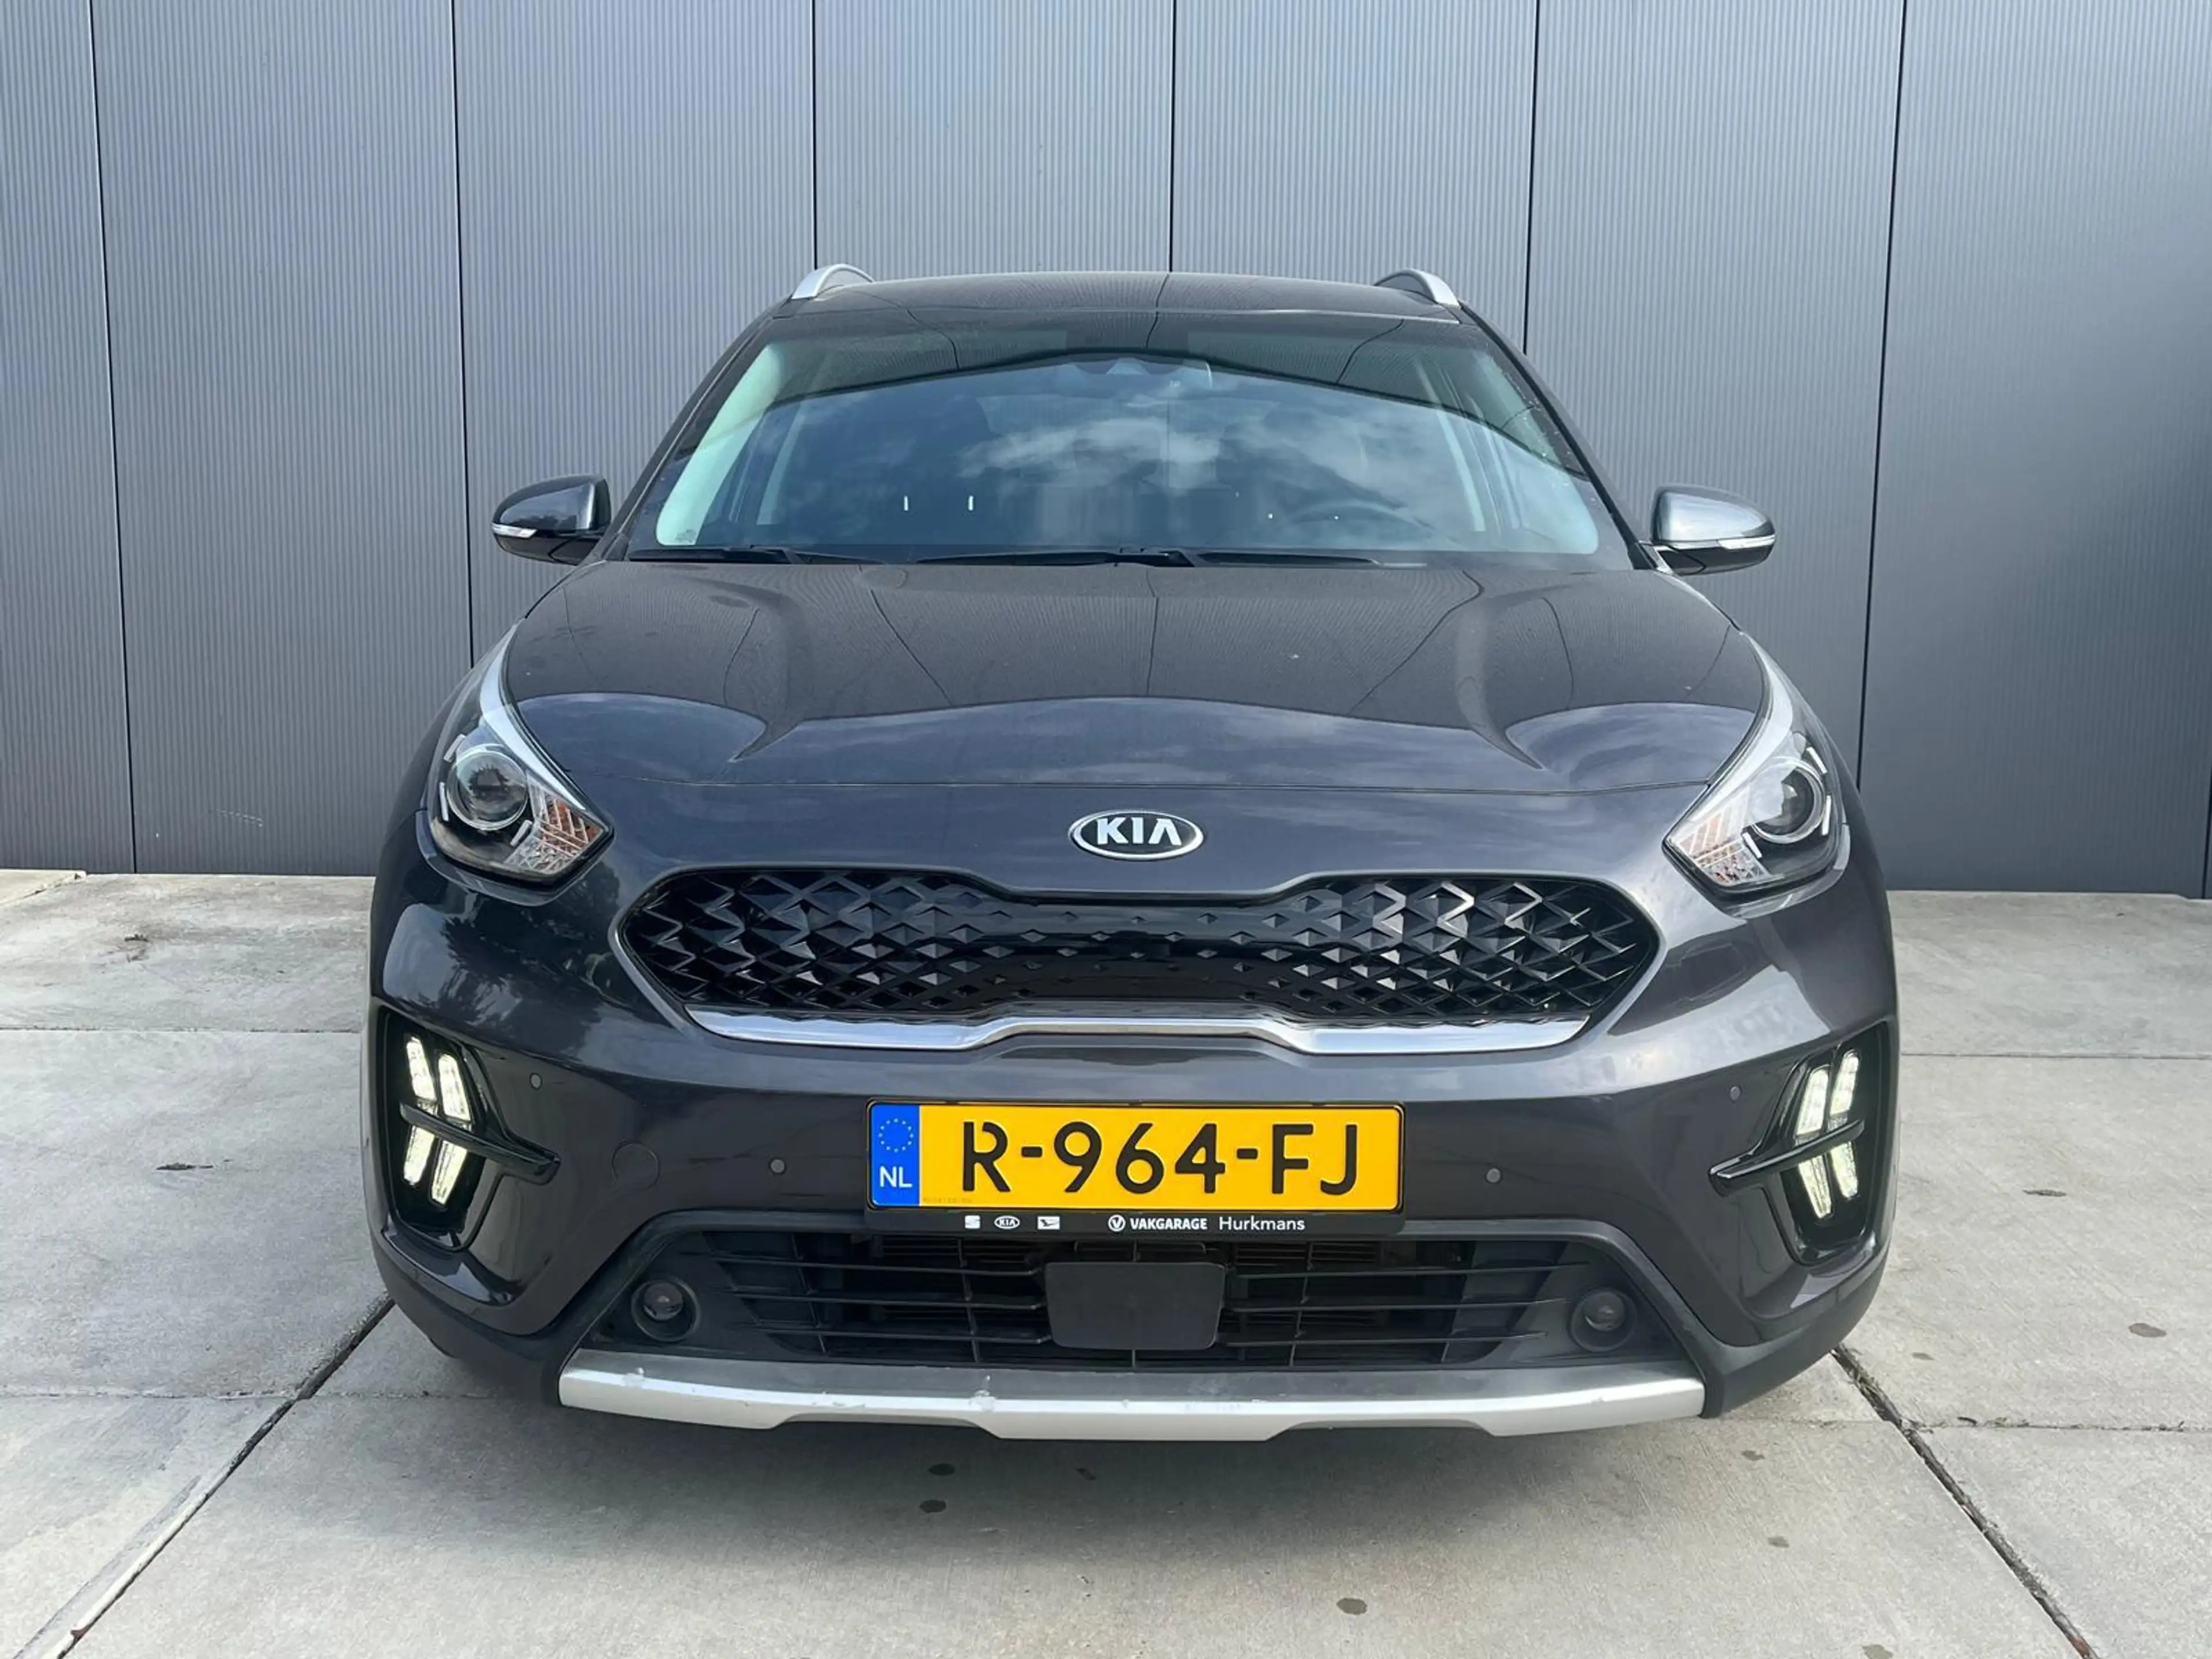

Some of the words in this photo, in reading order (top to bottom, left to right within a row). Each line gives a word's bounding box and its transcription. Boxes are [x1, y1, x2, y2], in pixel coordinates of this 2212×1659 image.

[1096, 817, 1182, 846] KIA
[963, 1121, 1358, 1195] R-964-FJ
[879, 1165, 913, 1188] NL
[998, 1217, 1016, 1228] KIA
[1130, 1218, 1208, 1230] VAKGARAGE
[1219, 1215, 1305, 1230] Hurkmans
